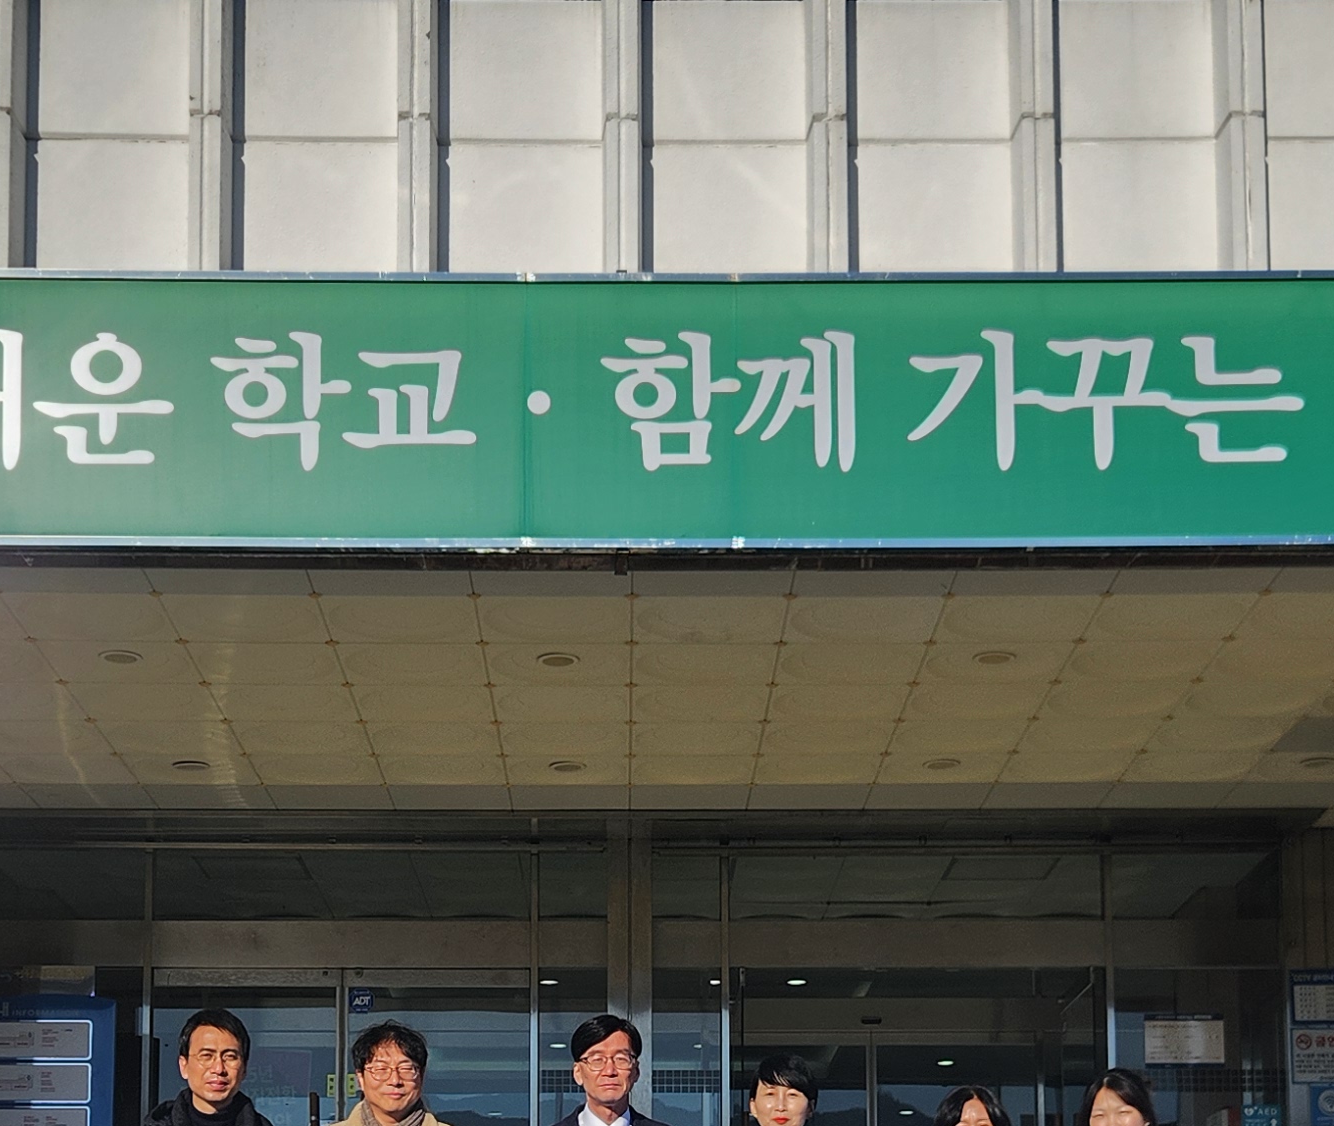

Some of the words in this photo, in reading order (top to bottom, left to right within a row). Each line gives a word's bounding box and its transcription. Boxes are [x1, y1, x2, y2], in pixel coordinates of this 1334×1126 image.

[210, 331, 477, 471] 학교
[601, 328, 855, 471] 함께
[909, 328, 1304, 471] 가꾸는
[352, 996, 371, 1006] ADT
[1257, 1108, 1277, 1116] AED
